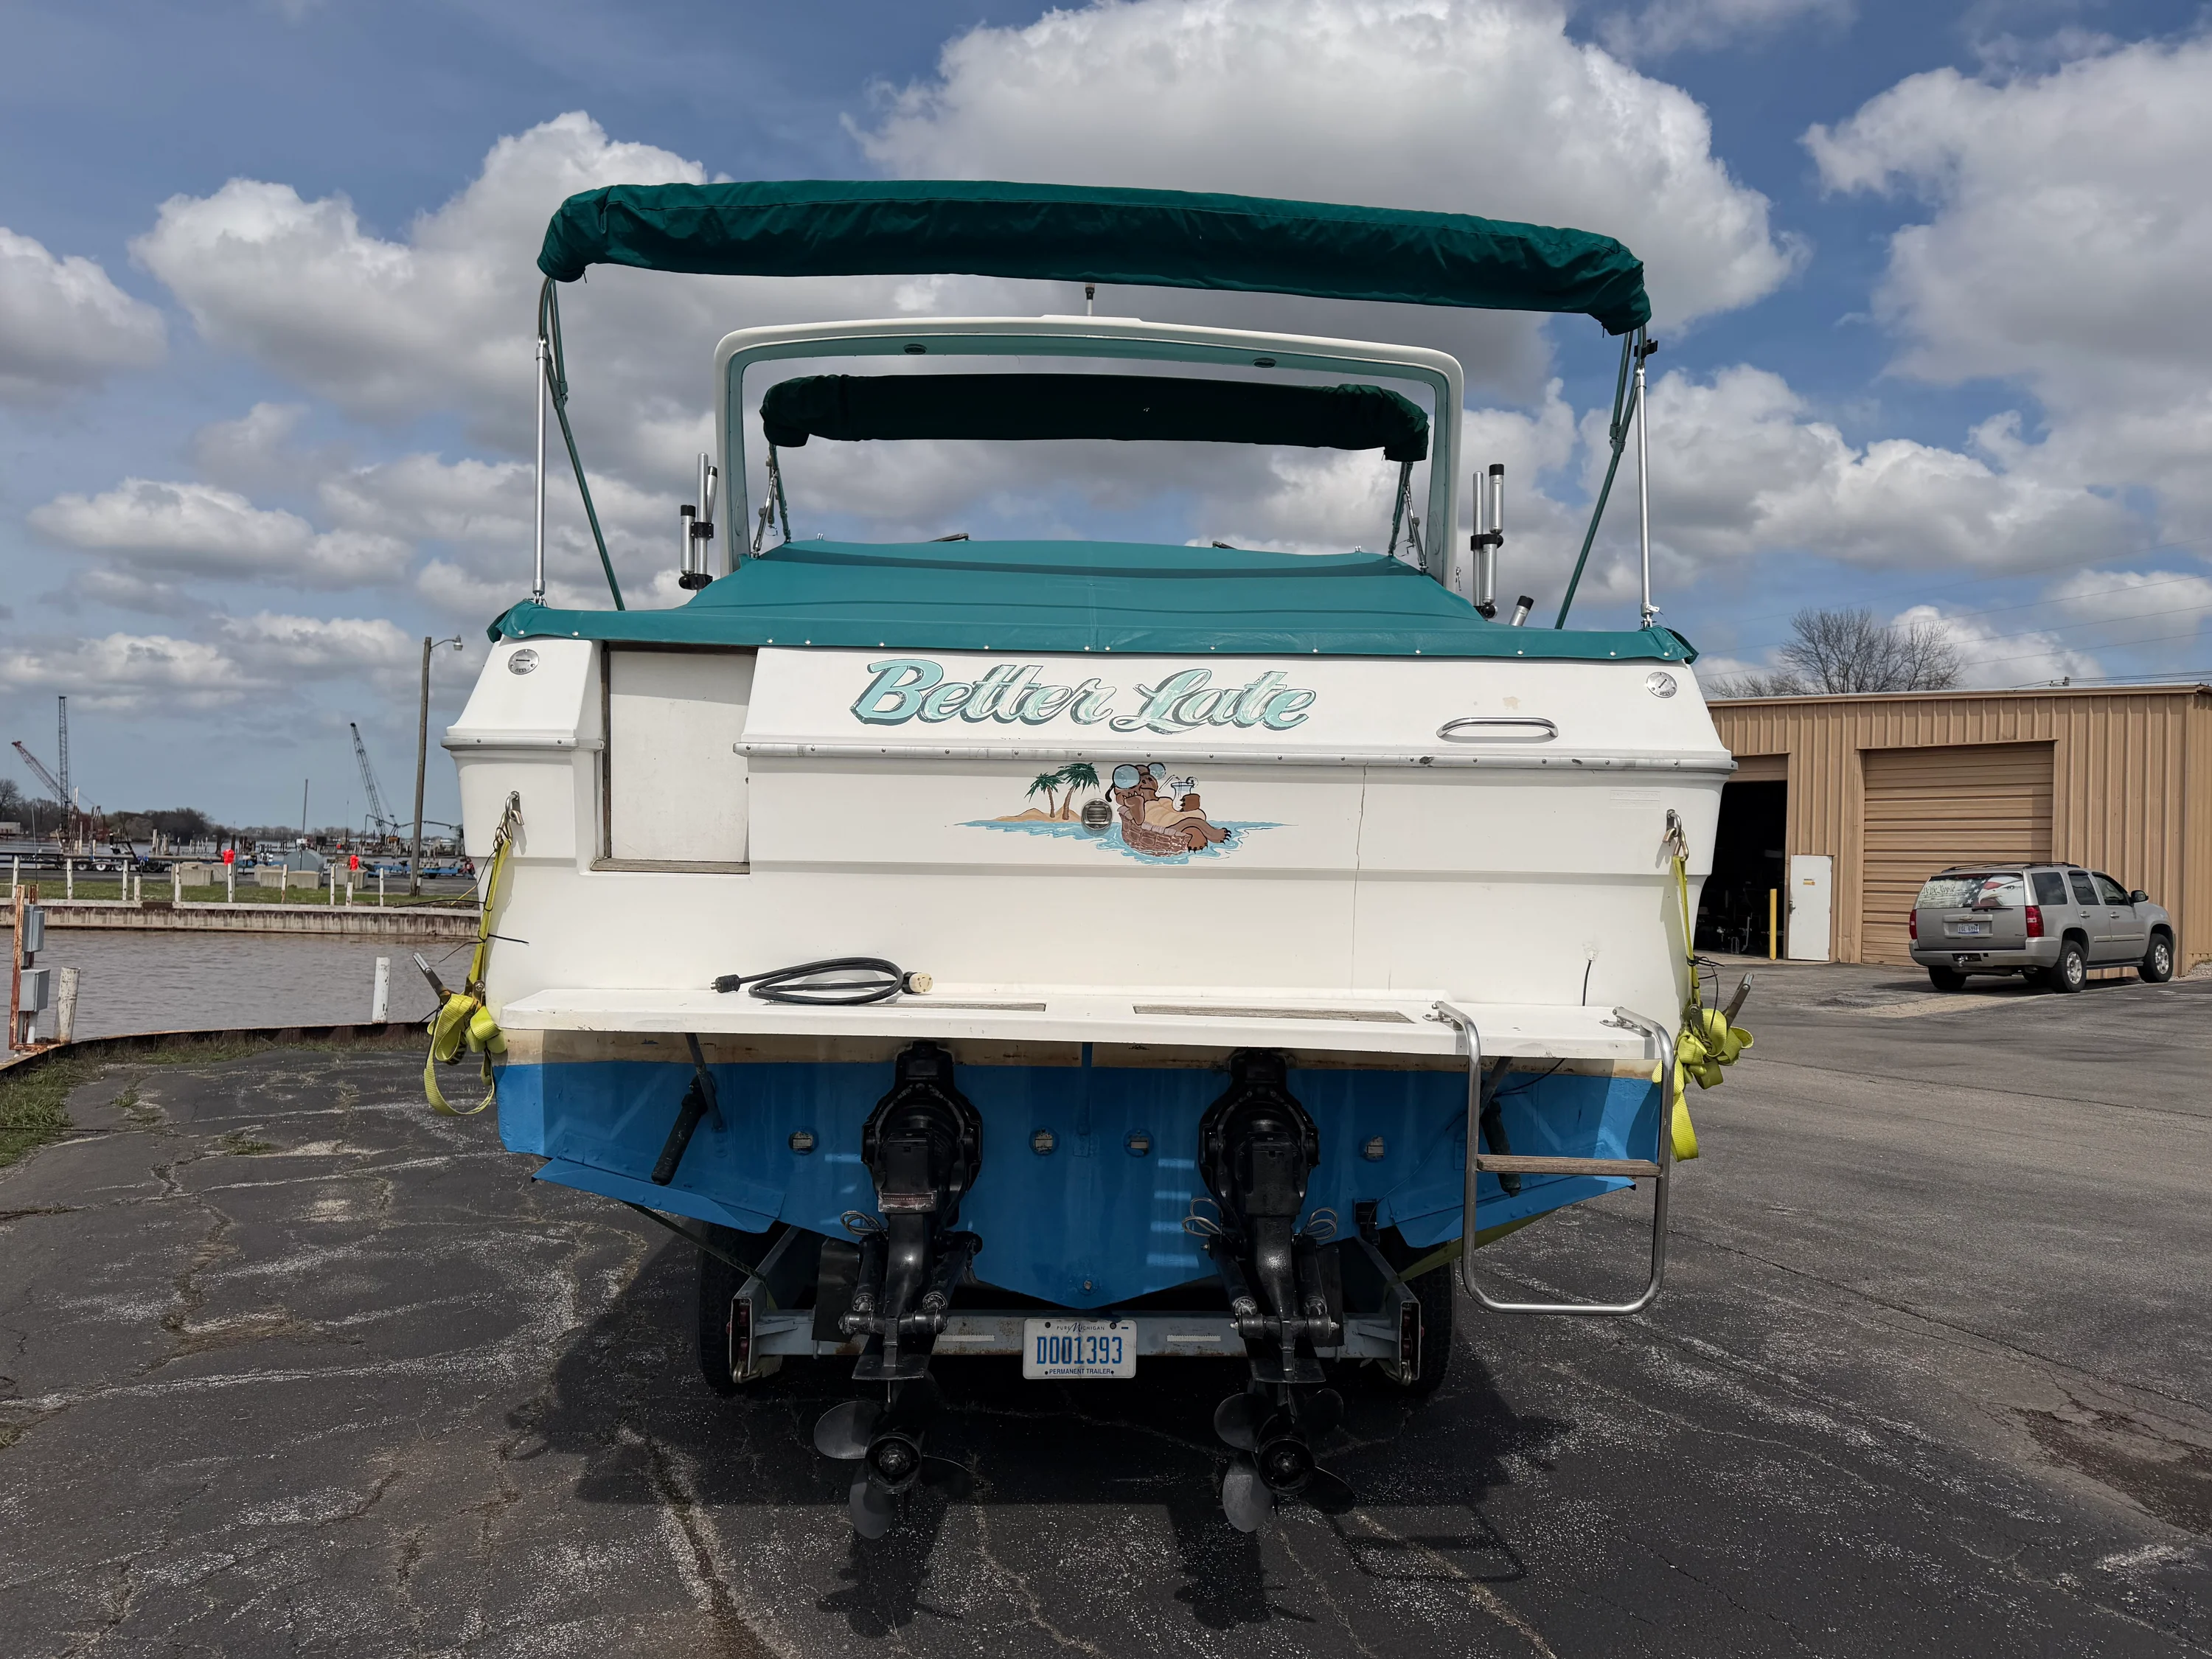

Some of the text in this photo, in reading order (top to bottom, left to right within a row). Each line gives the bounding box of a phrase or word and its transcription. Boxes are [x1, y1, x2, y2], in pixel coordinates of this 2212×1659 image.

[849, 658, 1318, 734] Better Late
[1066, 1322, 1105, 1334] MICHIGAN
[1037, 1335, 1122, 1365] D001393
